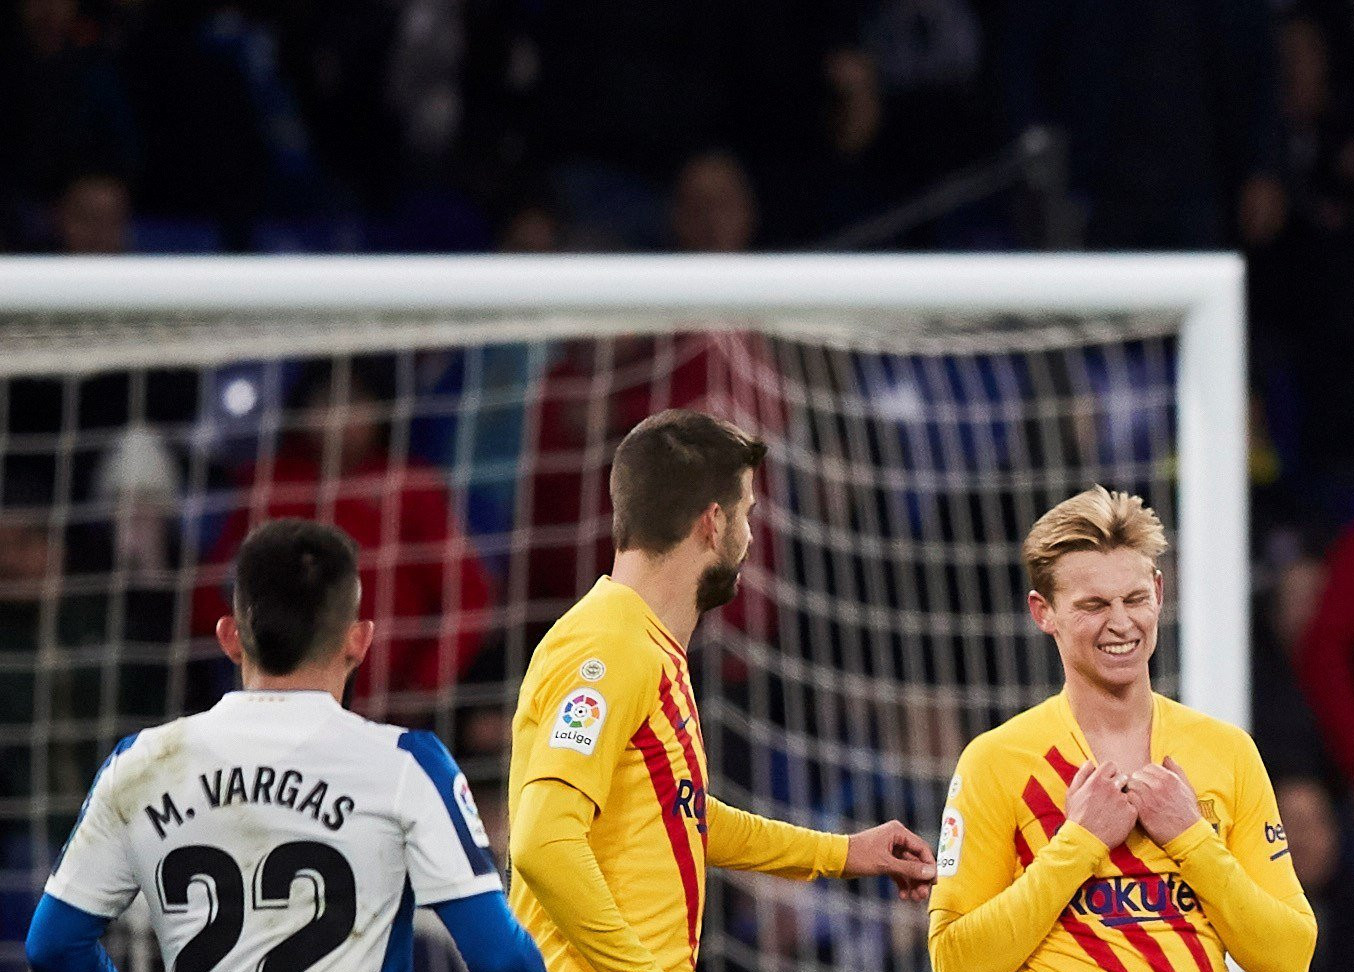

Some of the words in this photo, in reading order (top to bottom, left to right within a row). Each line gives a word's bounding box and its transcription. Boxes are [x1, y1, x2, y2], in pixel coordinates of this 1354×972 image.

[555, 730, 592, 746] LaLiga
[144, 792, 195, 840] M.
[200, 766, 355, 832] VARGAS
